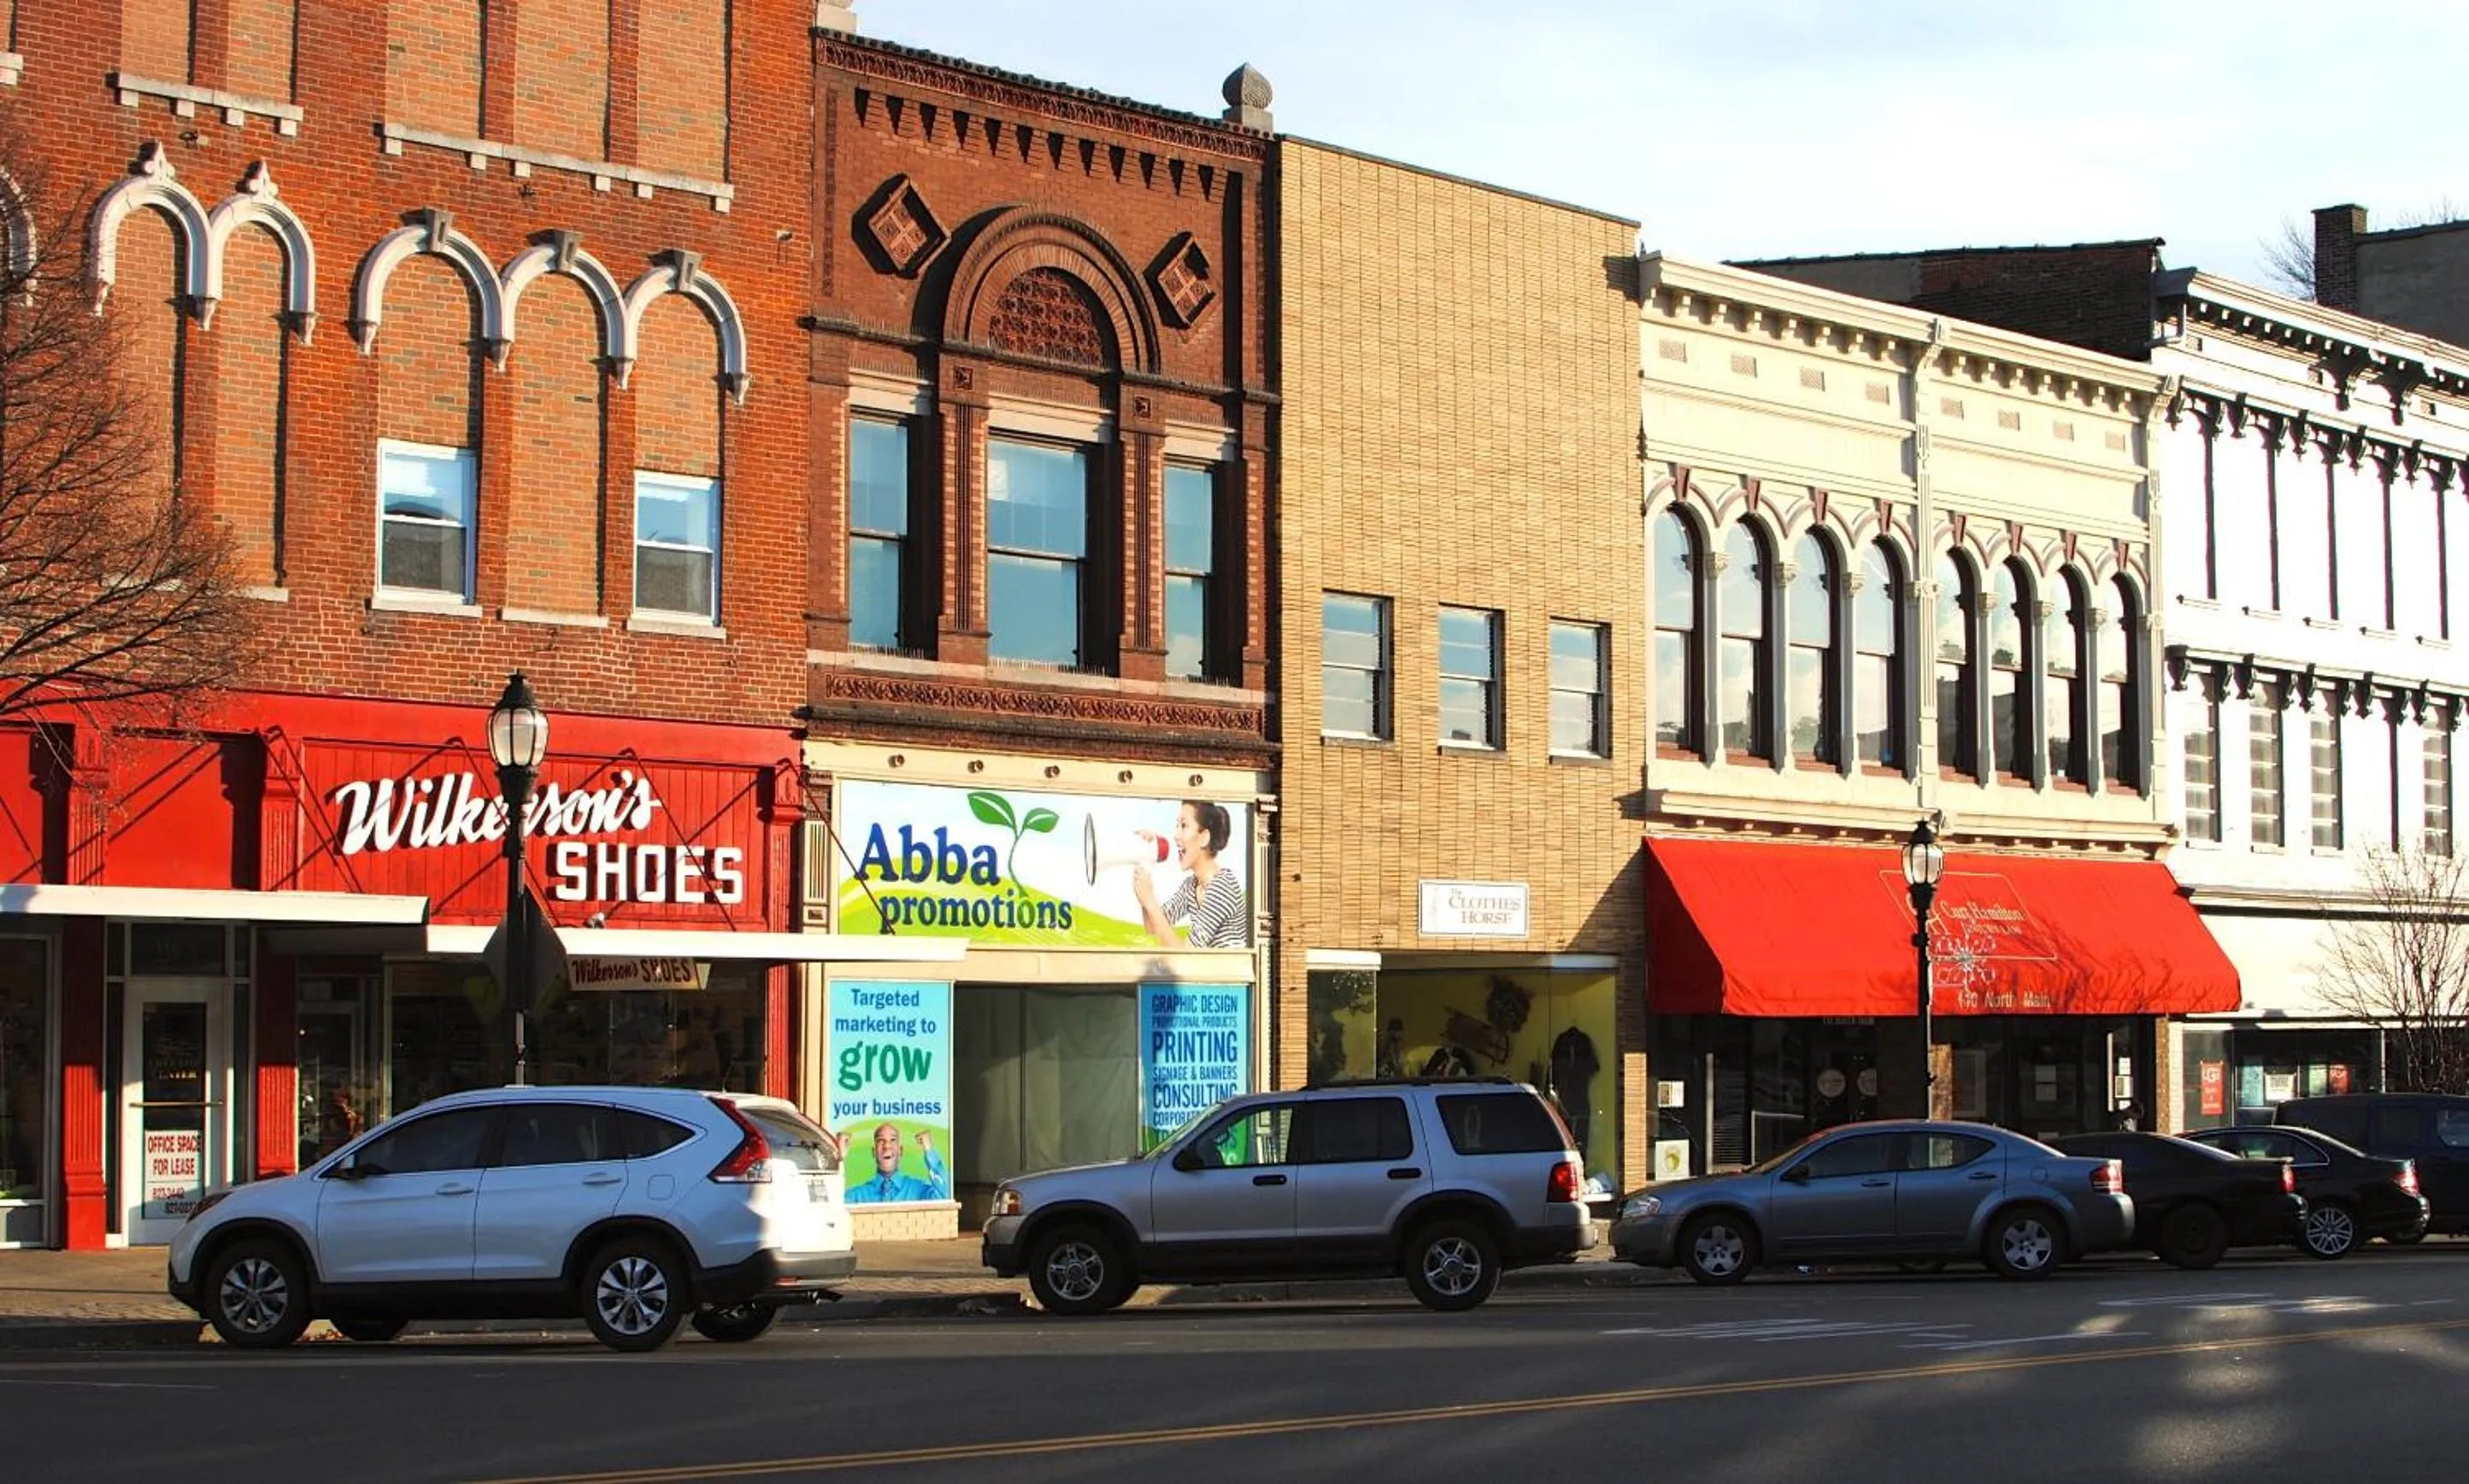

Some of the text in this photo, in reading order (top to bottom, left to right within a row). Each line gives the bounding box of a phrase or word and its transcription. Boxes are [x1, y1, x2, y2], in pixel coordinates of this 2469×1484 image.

[854, 822, 1001, 886] Abba
[555, 841, 744, 905] SHOES
[879, 889, 1073, 935] promotions
[1448, 896, 1521, 911] CLOTHES
[1461, 911, 1514, 924] HORSE
[641, 957, 691, 982] SHOES
[850, 988, 920, 1010] Targeted
[1151, 994, 1238, 1014] GRAPHIC DESIGN
[834, 1015, 937, 1038] marketing to
[1202, 1015, 1238, 1028] PRODUCTS
[1151, 1029, 1238, 1064] PRINTING
[838, 1040, 933, 1092] grow
[1152, 1065, 1238, 1081] SIGNAGE & BANNERS
[833, 1097, 943, 1119] your business
[1152, 1111, 1201, 1127] CORPORA
[148, 1135, 203, 1153] OFFICE SPACE
[153, 1158, 195, 1176] FOR LEASE
